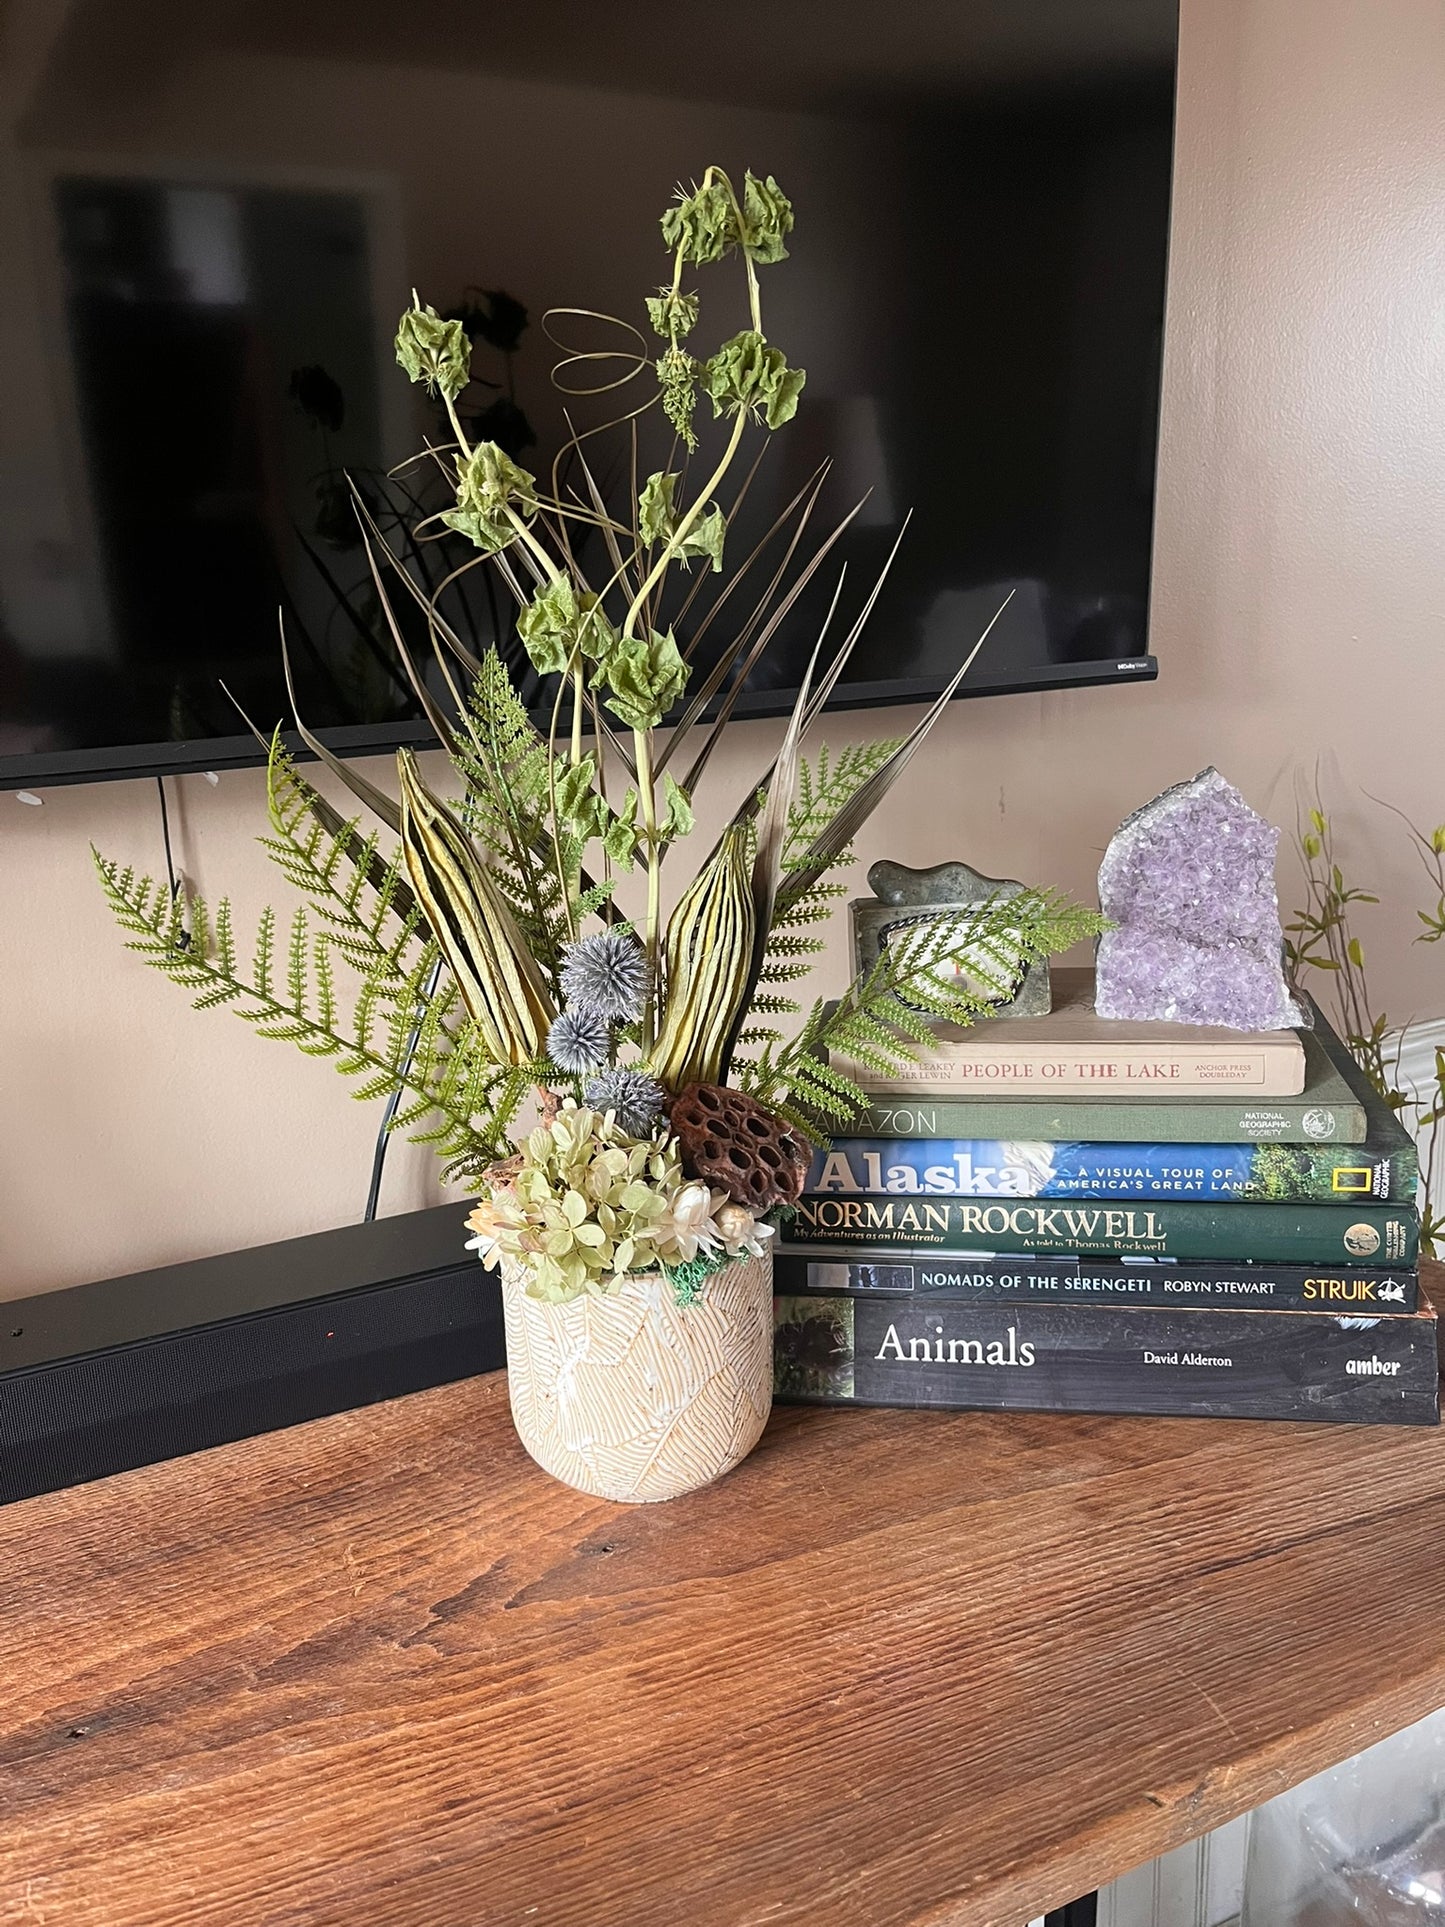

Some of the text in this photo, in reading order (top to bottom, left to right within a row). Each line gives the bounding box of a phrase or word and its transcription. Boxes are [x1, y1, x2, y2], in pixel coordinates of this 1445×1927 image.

[886, 1072, 917, 1080] RGER
[963, 1064, 1180, 1078] PEOPLE OF THE LAKE
[814, 1109, 936, 1133] AMAZON
[1239, 1120, 1291, 1128] GEOGRAPHIC
[1244, 1112, 1284, 1120] NATIONAL
[813, 1152, 1036, 1194] Alaska
[1078, 1167, 1234, 1178] A VISUAL TOUR OF
[1372, 1163, 1382, 1195] NATIONAL
[1380, 1159, 1390, 1199] GEOGRAPHIC
[1057, 1181, 1255, 1191] AMERICA'S GREAT LAND
[794, 1200, 1168, 1240] NORMAN ROCKWELL
[793, 1228, 809, 1240] My
[811, 1228, 864, 1240] Adventures
[892, 1231, 946, 1243] Illustrator
[1055, 1239, 1064, 1247] to
[1065, 1238, 1110, 1249] Thomas
[1113, 1240, 1166, 1251] Rockwell
[921, 1272, 1152, 1293] NOMADS OF THE SERENGETI
[1163, 1280, 1276, 1295] ROBYN STEWART
[1303, 1278, 1378, 1301] STRUIK
[874, 1323, 1036, 1367] Animals
[1144, 1351, 1232, 1367] David Alderton
[1345, 1356, 1401, 1377] amber
